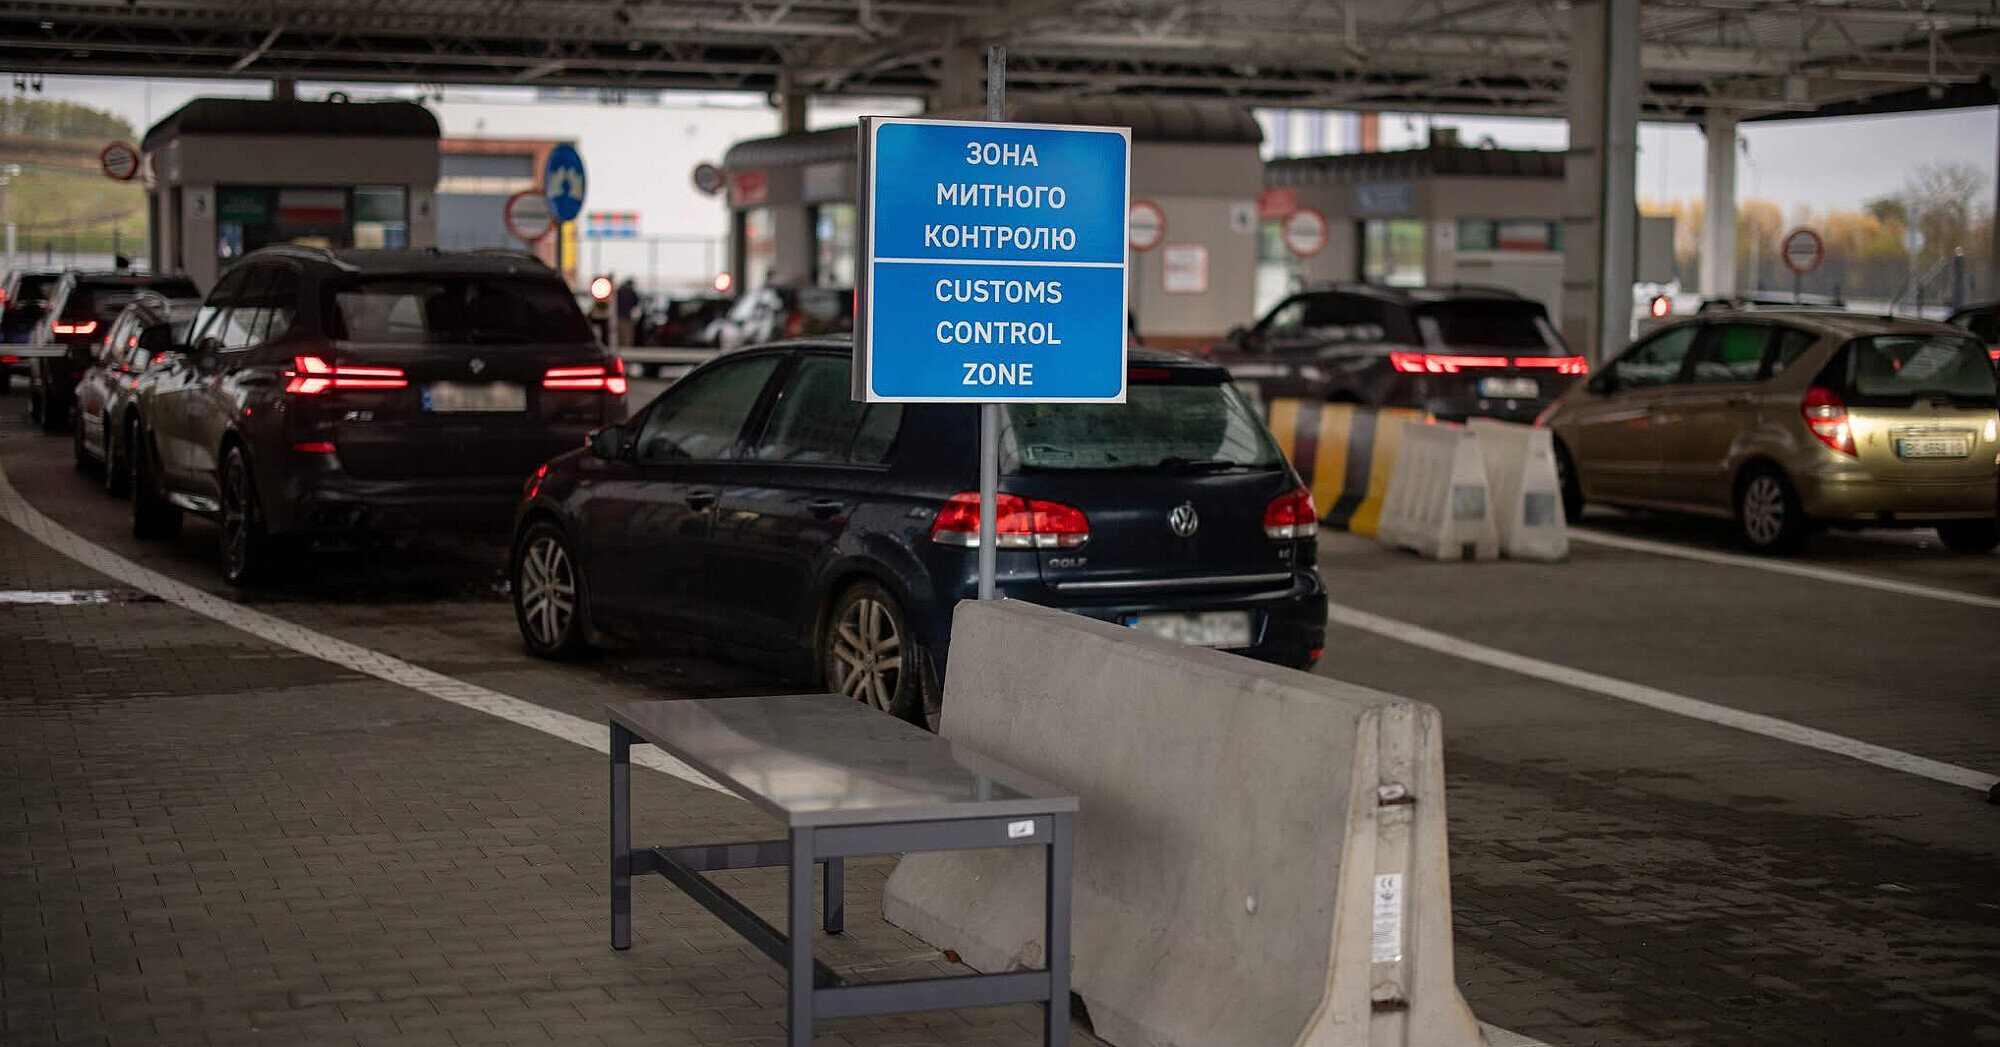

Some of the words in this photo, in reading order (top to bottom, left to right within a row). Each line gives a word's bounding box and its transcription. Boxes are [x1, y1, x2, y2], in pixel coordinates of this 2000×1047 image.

[966, 142, 1039, 167] ЗОНА
[937, 183, 1066, 209] МИТНОГО
[924, 224, 1077, 251] КОНТРОЛЮ
[935, 279, 1063, 304] CUSTOMS
[936, 320, 1062, 345] CONTROL
[962, 362, 1034, 386] ZONE
[1049, 557, 1088, 569] GOLF
